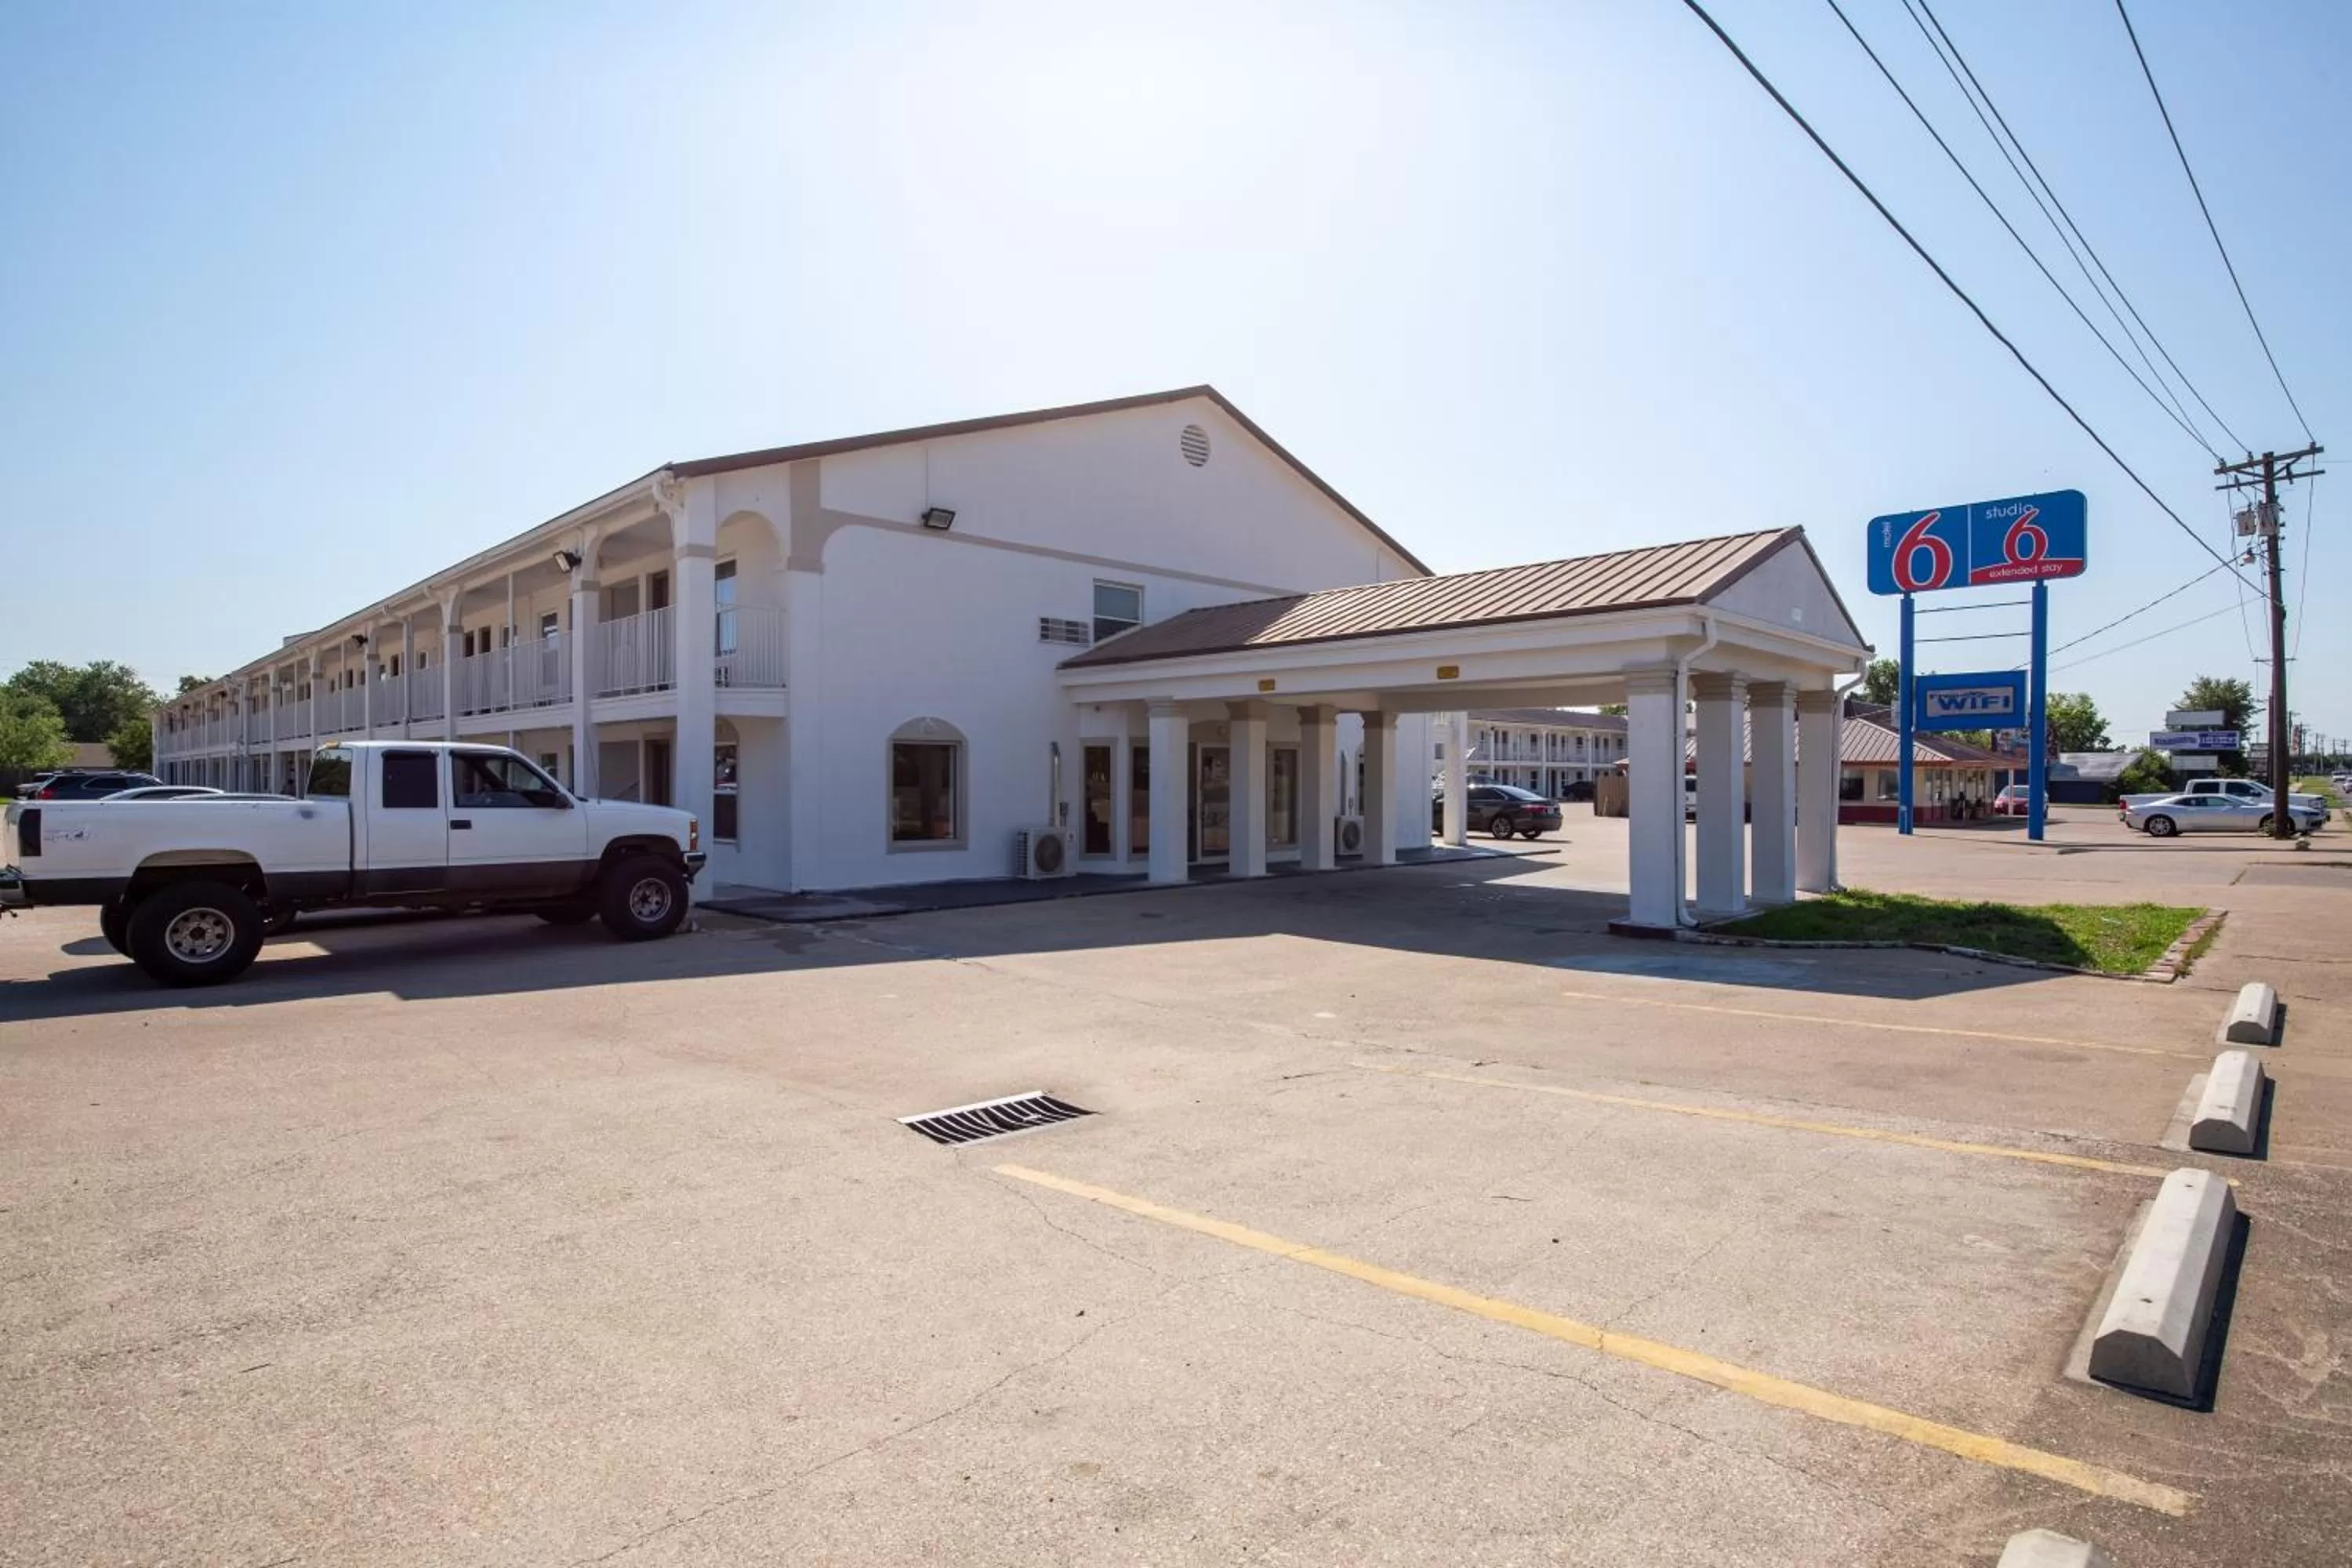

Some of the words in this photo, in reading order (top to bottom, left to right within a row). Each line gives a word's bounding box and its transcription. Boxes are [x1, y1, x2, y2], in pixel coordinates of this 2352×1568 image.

[1986, 502, 2034, 519] studio
[1892, 510, 1953, 592] 6
[2003, 507, 2048, 563] 6
[1989, 564, 2038, 578] extended
[2042, 564, 2063, 574] stay
